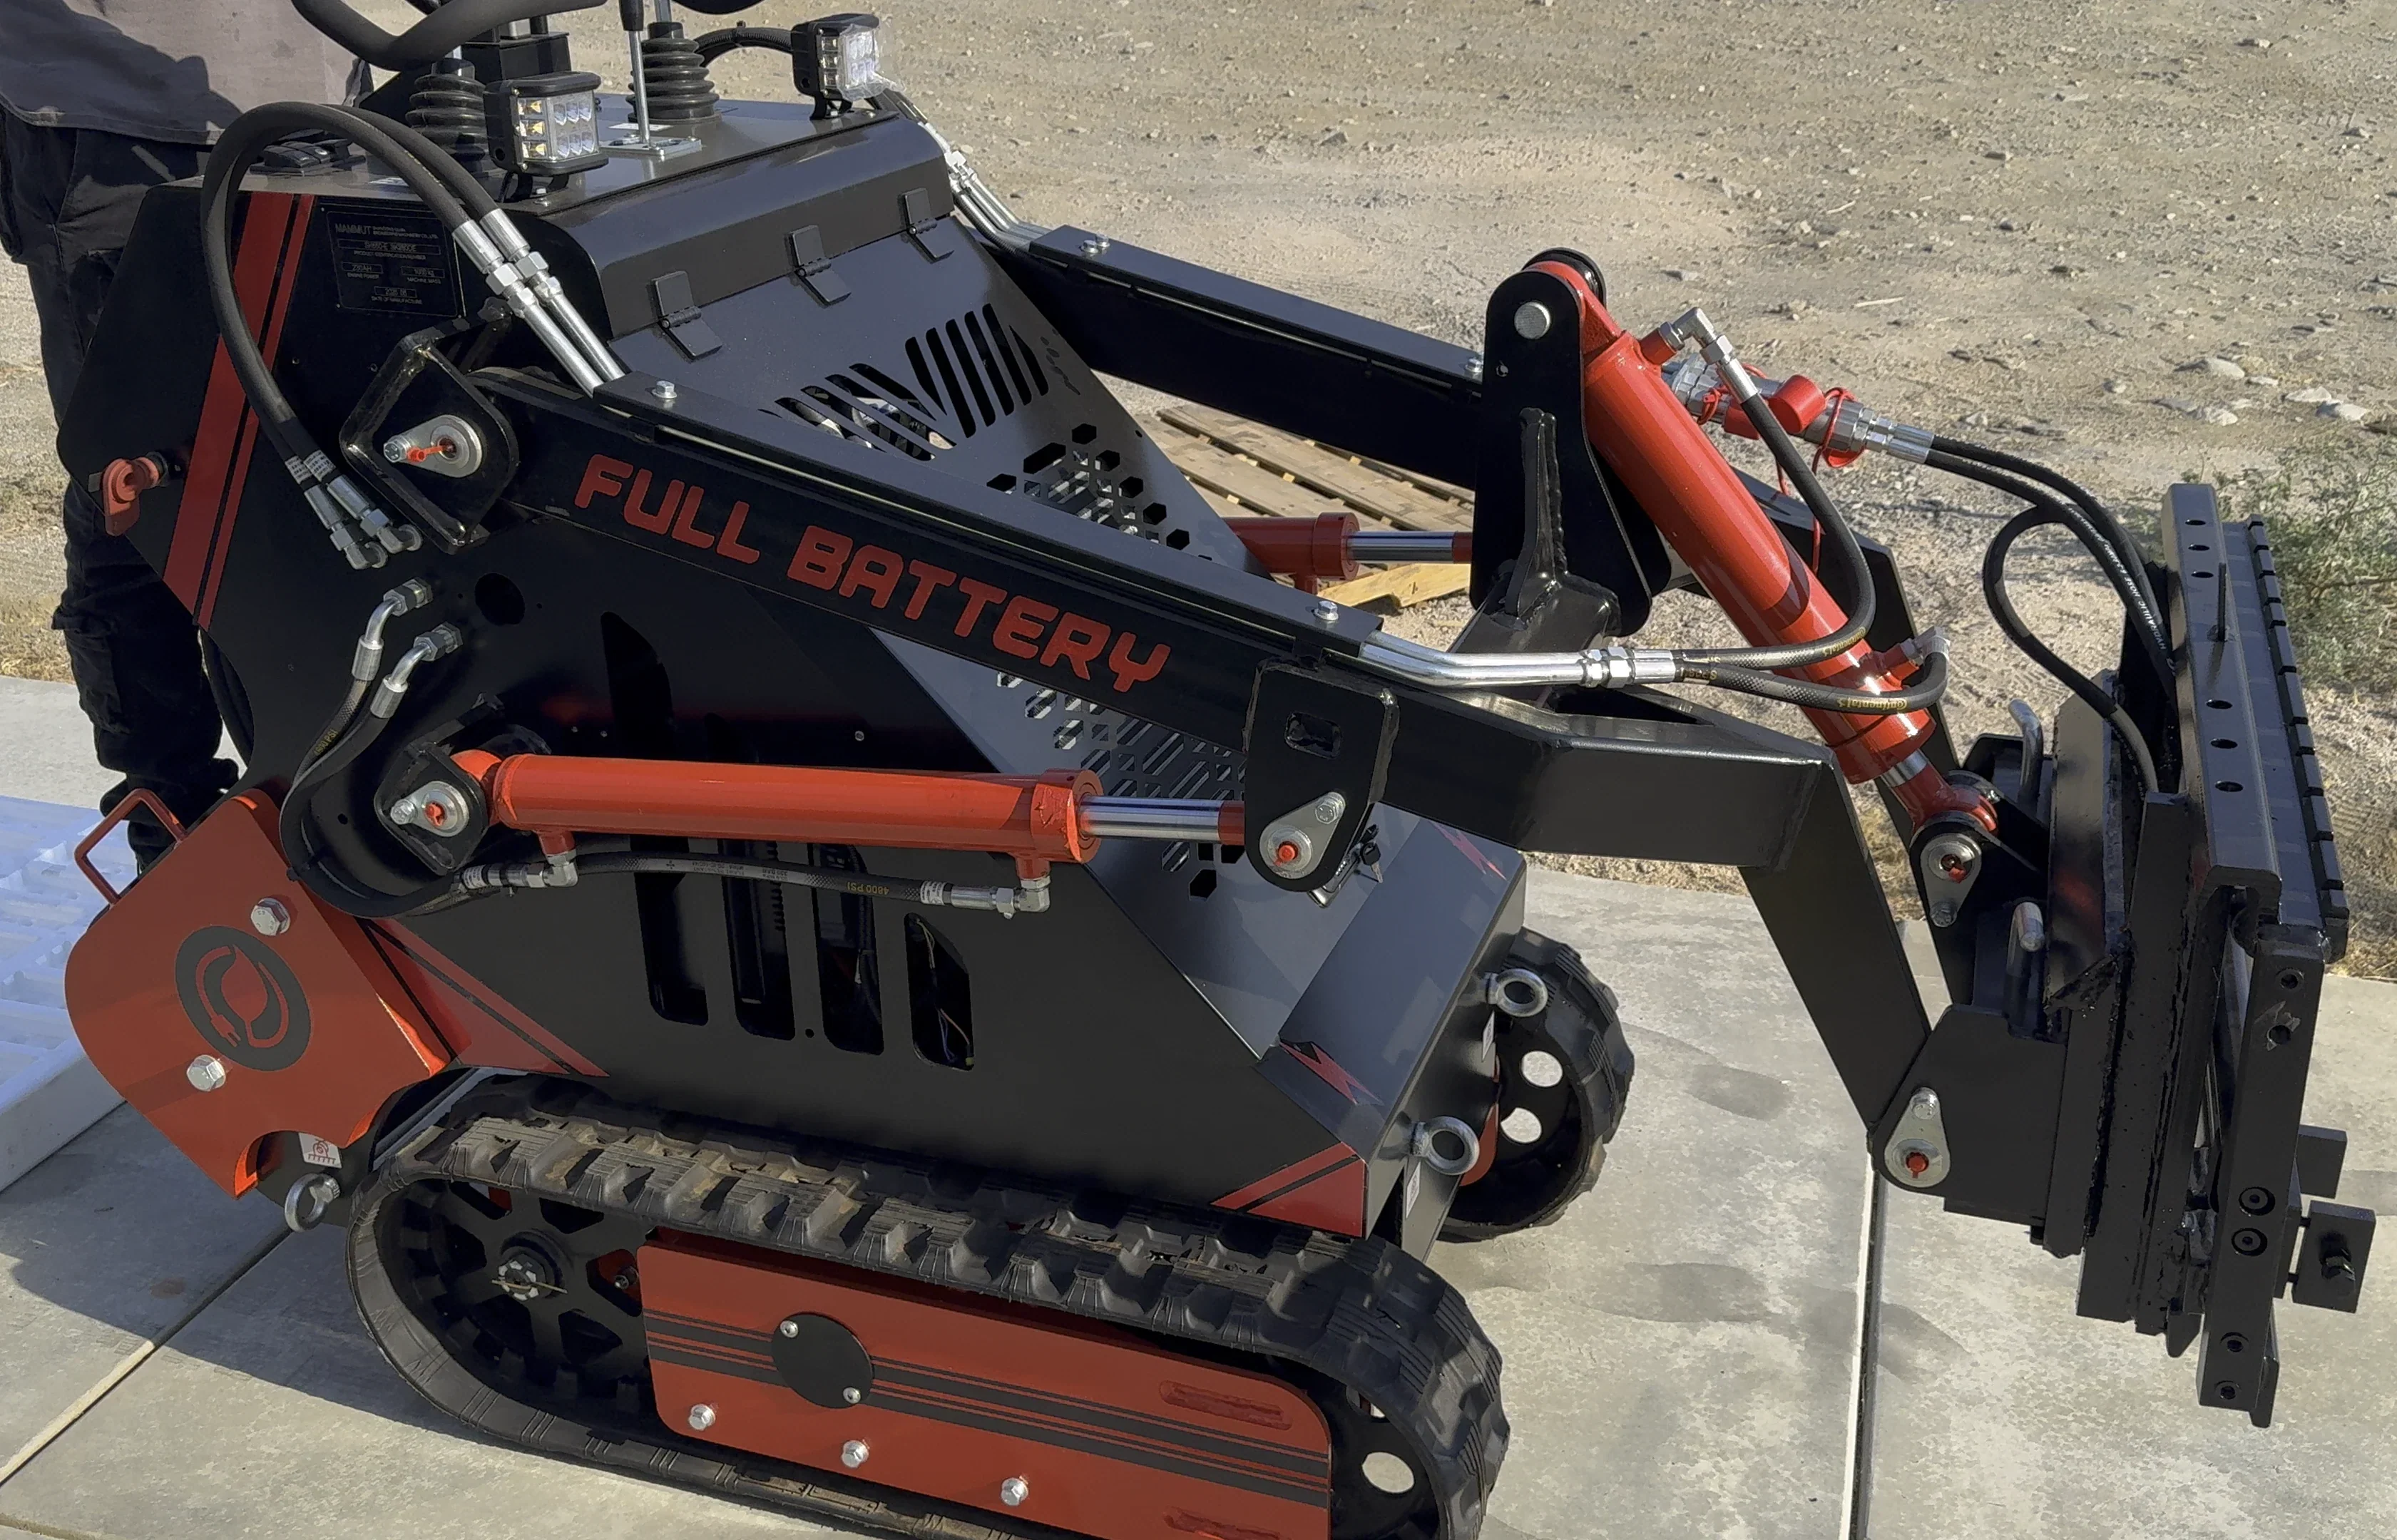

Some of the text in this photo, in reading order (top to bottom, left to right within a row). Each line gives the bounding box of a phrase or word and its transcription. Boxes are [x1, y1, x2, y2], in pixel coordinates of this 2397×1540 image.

[335, 223, 372, 235] MAMMUT
[574, 453, 1172, 694] FULL BATTERY
[2124, 576, 2167, 650] HYDRAULIC HOSE
[1846, 697, 1908, 712] Continental
[847, 881, 890, 895] 4800 PSI
